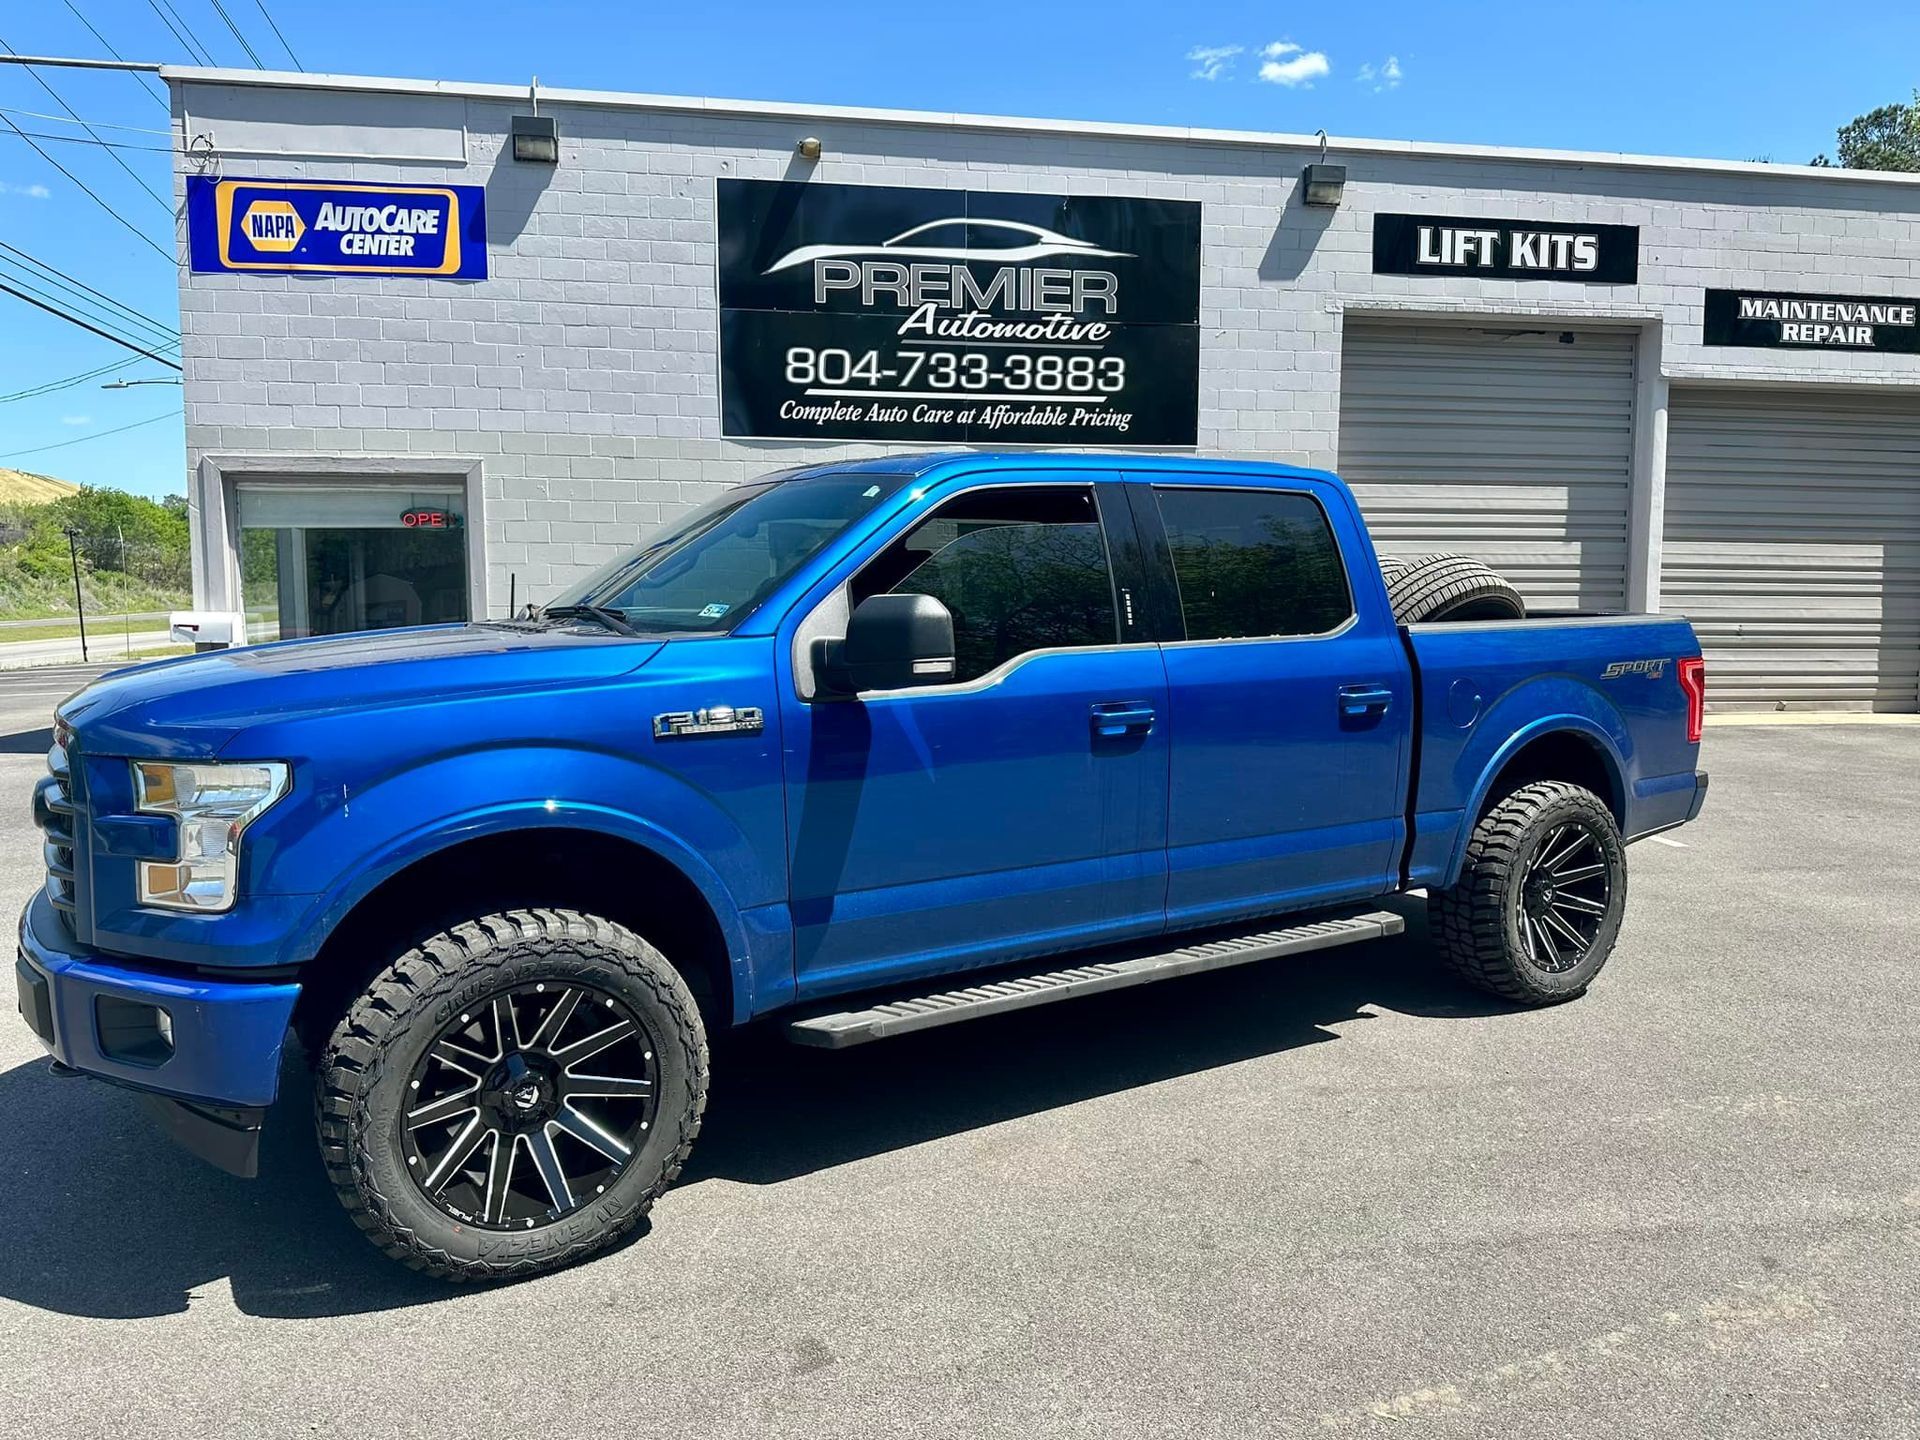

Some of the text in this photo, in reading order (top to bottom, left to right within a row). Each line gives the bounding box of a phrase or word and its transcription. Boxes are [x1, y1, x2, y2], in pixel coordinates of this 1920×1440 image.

[252, 214, 296, 239] NAPA
[314, 202, 440, 234] AUTOCARE
[339, 234, 415, 256] CENTER
[1416, 225, 1599, 271] LIFT KITS
[814, 259, 1119, 314] PREMIER
[897, 302, 1112, 342] Automotive
[1738, 297, 1917, 327] MAINTENANCE
[1779, 322, 1875, 347] REPAIR
[785, 346, 1126, 393] 804-733-3883
[779, 399, 1133, 432] Complete Auto Care at Affordable Pricing
[403, 513, 455, 528] OPE
[1600, 658, 1671, 680] SPORT
[446, 1203, 473, 1222] FUEL
